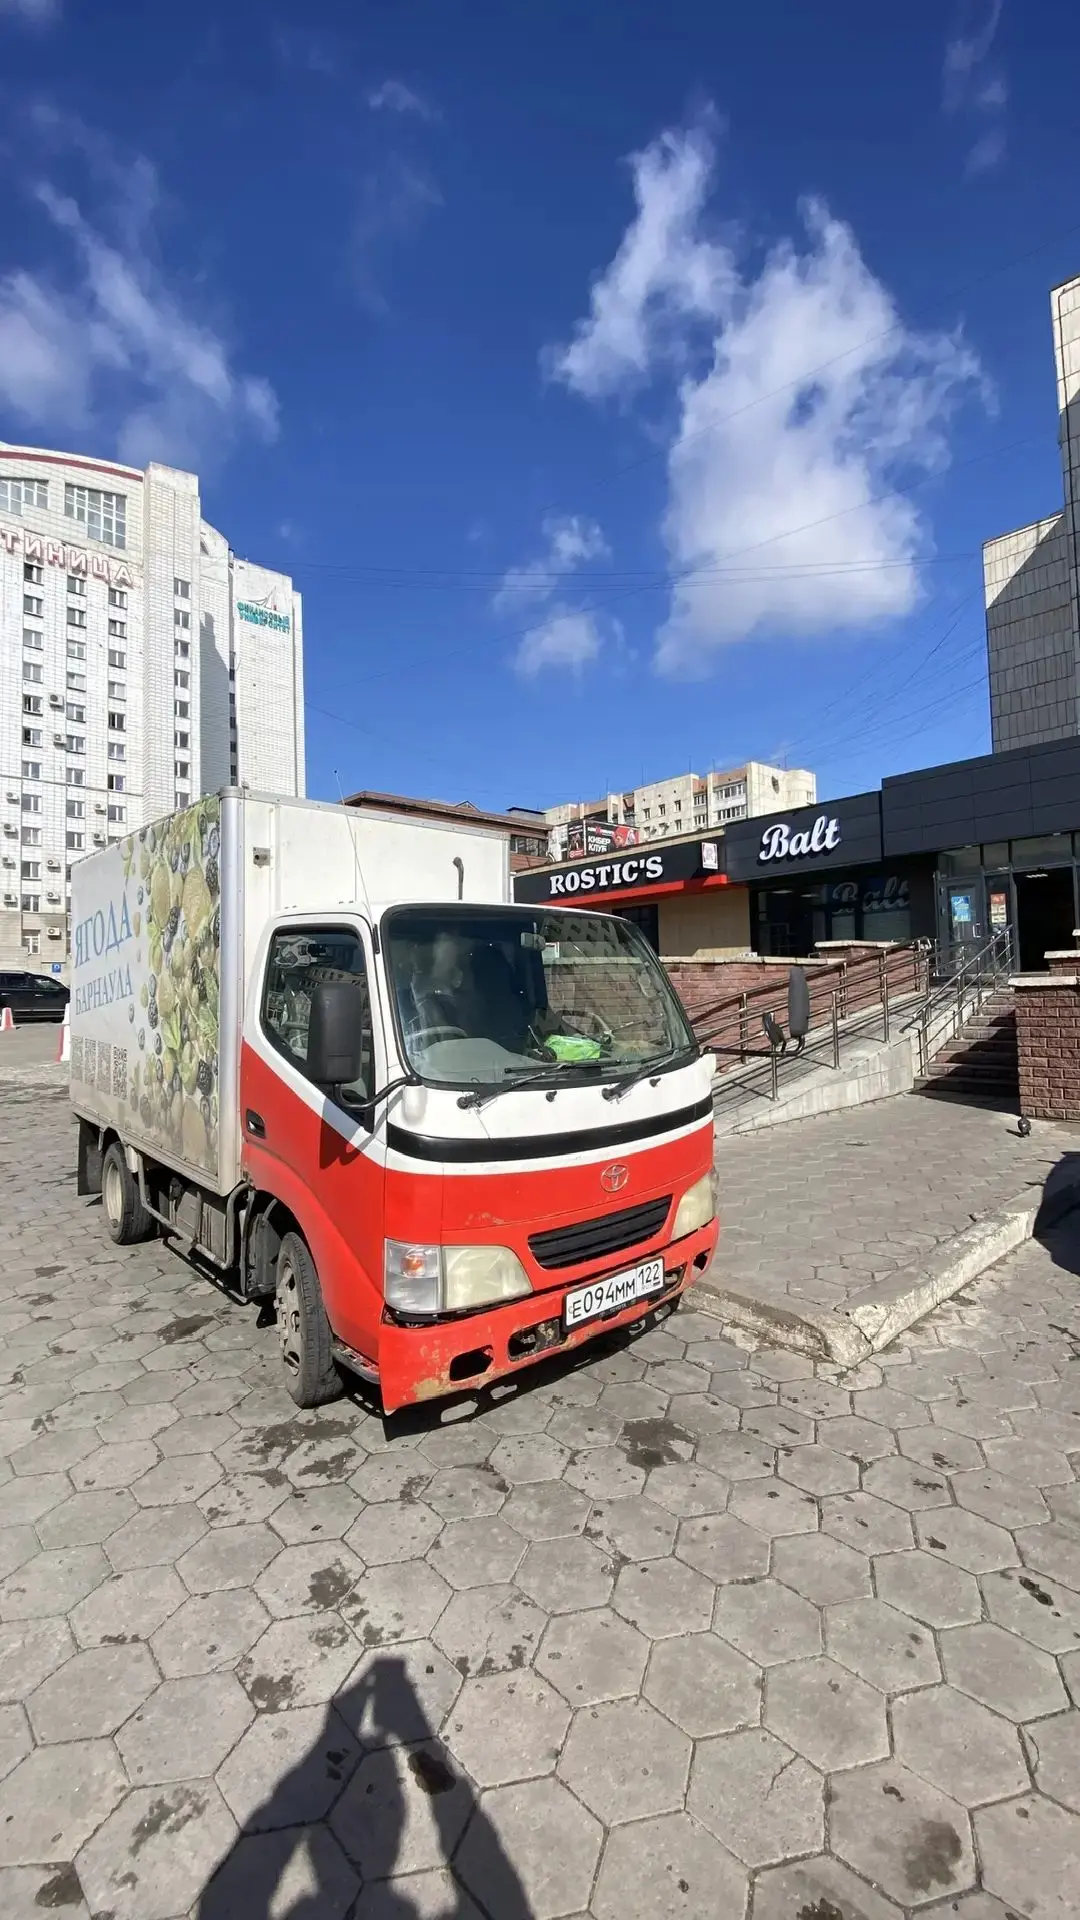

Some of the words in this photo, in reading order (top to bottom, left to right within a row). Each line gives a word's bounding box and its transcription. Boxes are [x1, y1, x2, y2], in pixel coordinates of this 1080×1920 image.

[588, 835, 611, 845] КИБЕР
[759, 815, 841, 860] Balt
[549, 856, 663, 894] ROSTIC'S
[75, 890, 132, 969] ЯГОДА
[76, 963, 133, 1015] БАРНАУЛА
